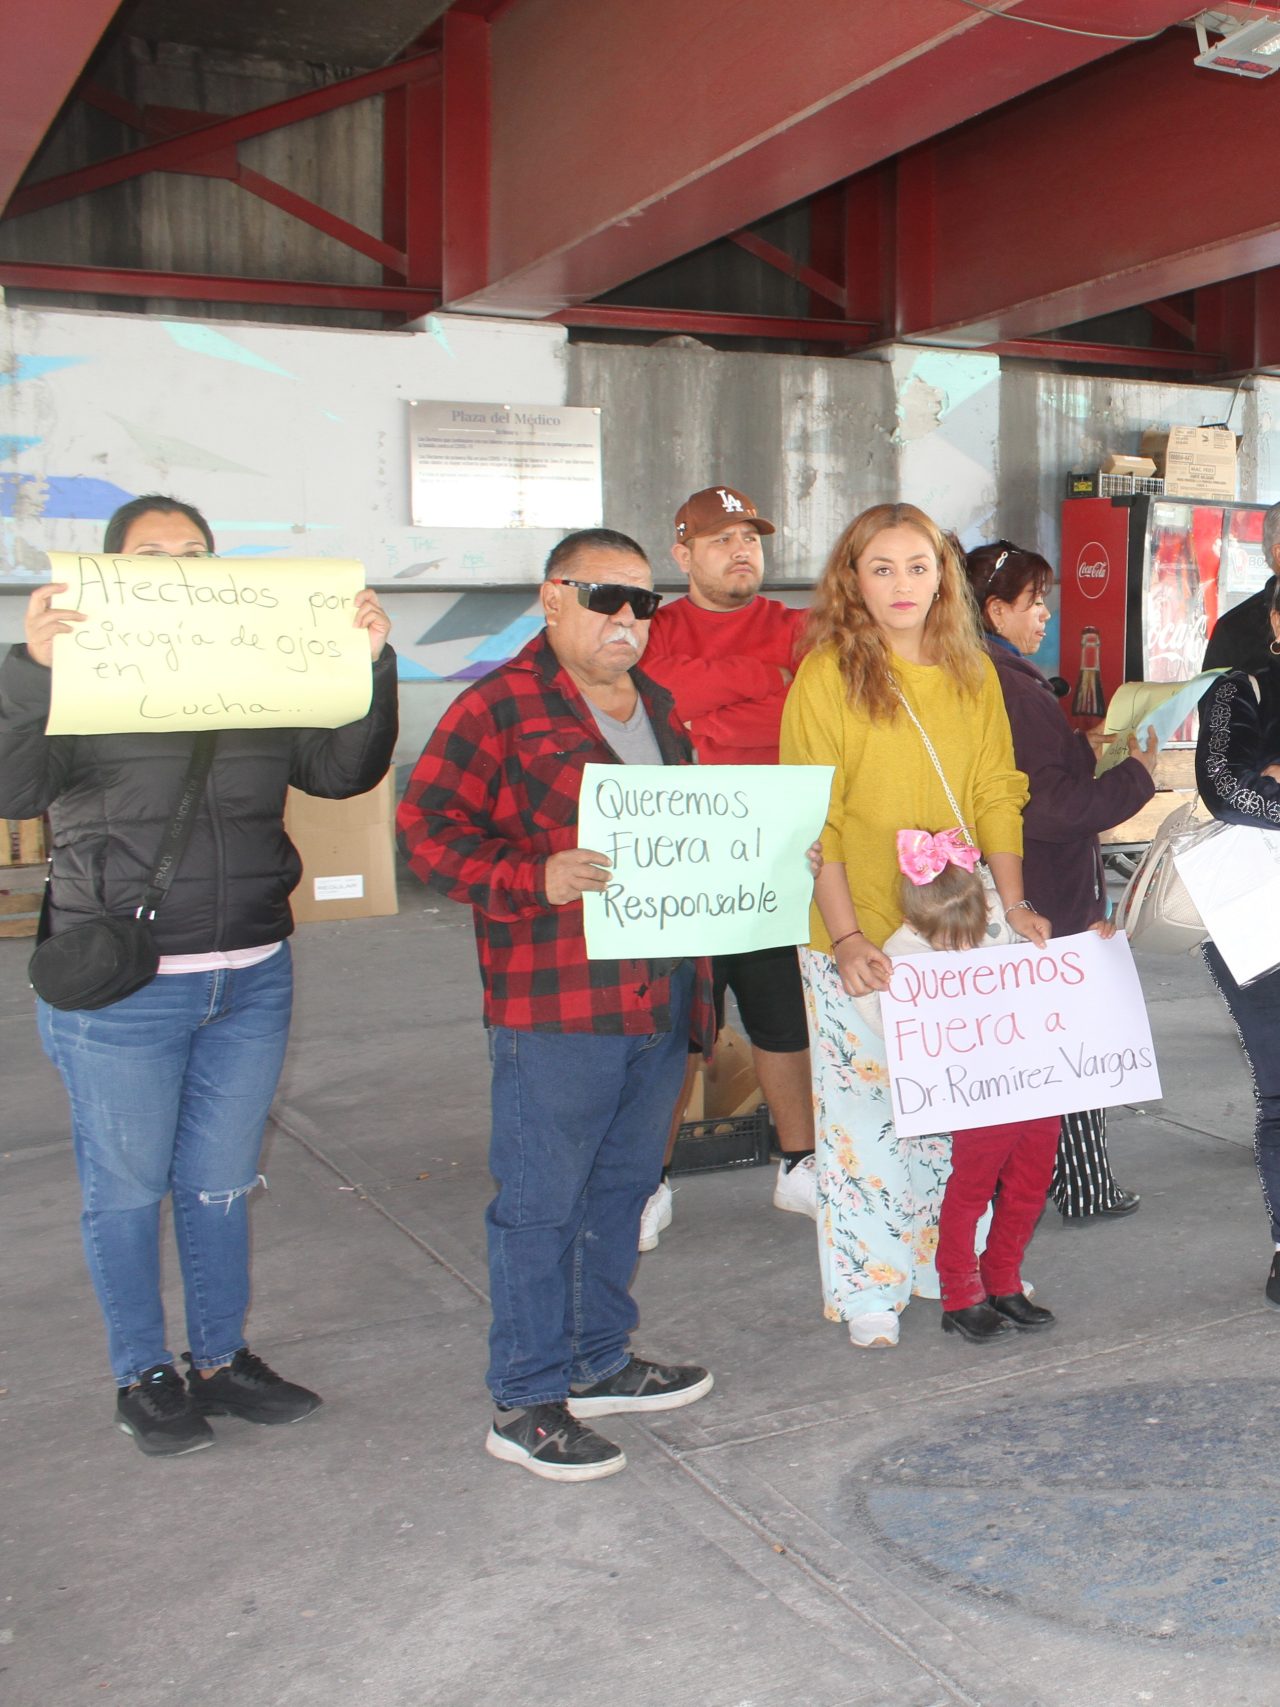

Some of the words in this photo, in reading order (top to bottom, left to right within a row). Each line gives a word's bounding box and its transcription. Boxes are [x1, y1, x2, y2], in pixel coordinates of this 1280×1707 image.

[451, 409, 486, 424] Plaza
[490, 411, 510, 424] del
[515, 412, 561, 426] Médico
[716, 489, 744, 513] LA
[76, 556, 280, 610] Afectados
[309, 591, 352, 627] por
[1079, 561, 1107, 578] Coca-Cola
[230, 624, 267, 650] de
[276, 628, 342, 673] ojos
[93, 661, 145, 684] en
[596, 778, 750, 820] Queremos
[605, 831, 710, 870] Fuera
[730, 827, 761, 862] al
[603, 882, 778, 931] Responsable
[887, 951, 1085, 1007] Queremos
[895, 1012, 1026, 1061] Fuera
[1044, 1012, 1067, 1032] a
[1058, 1042, 1152, 1088] Vargas
